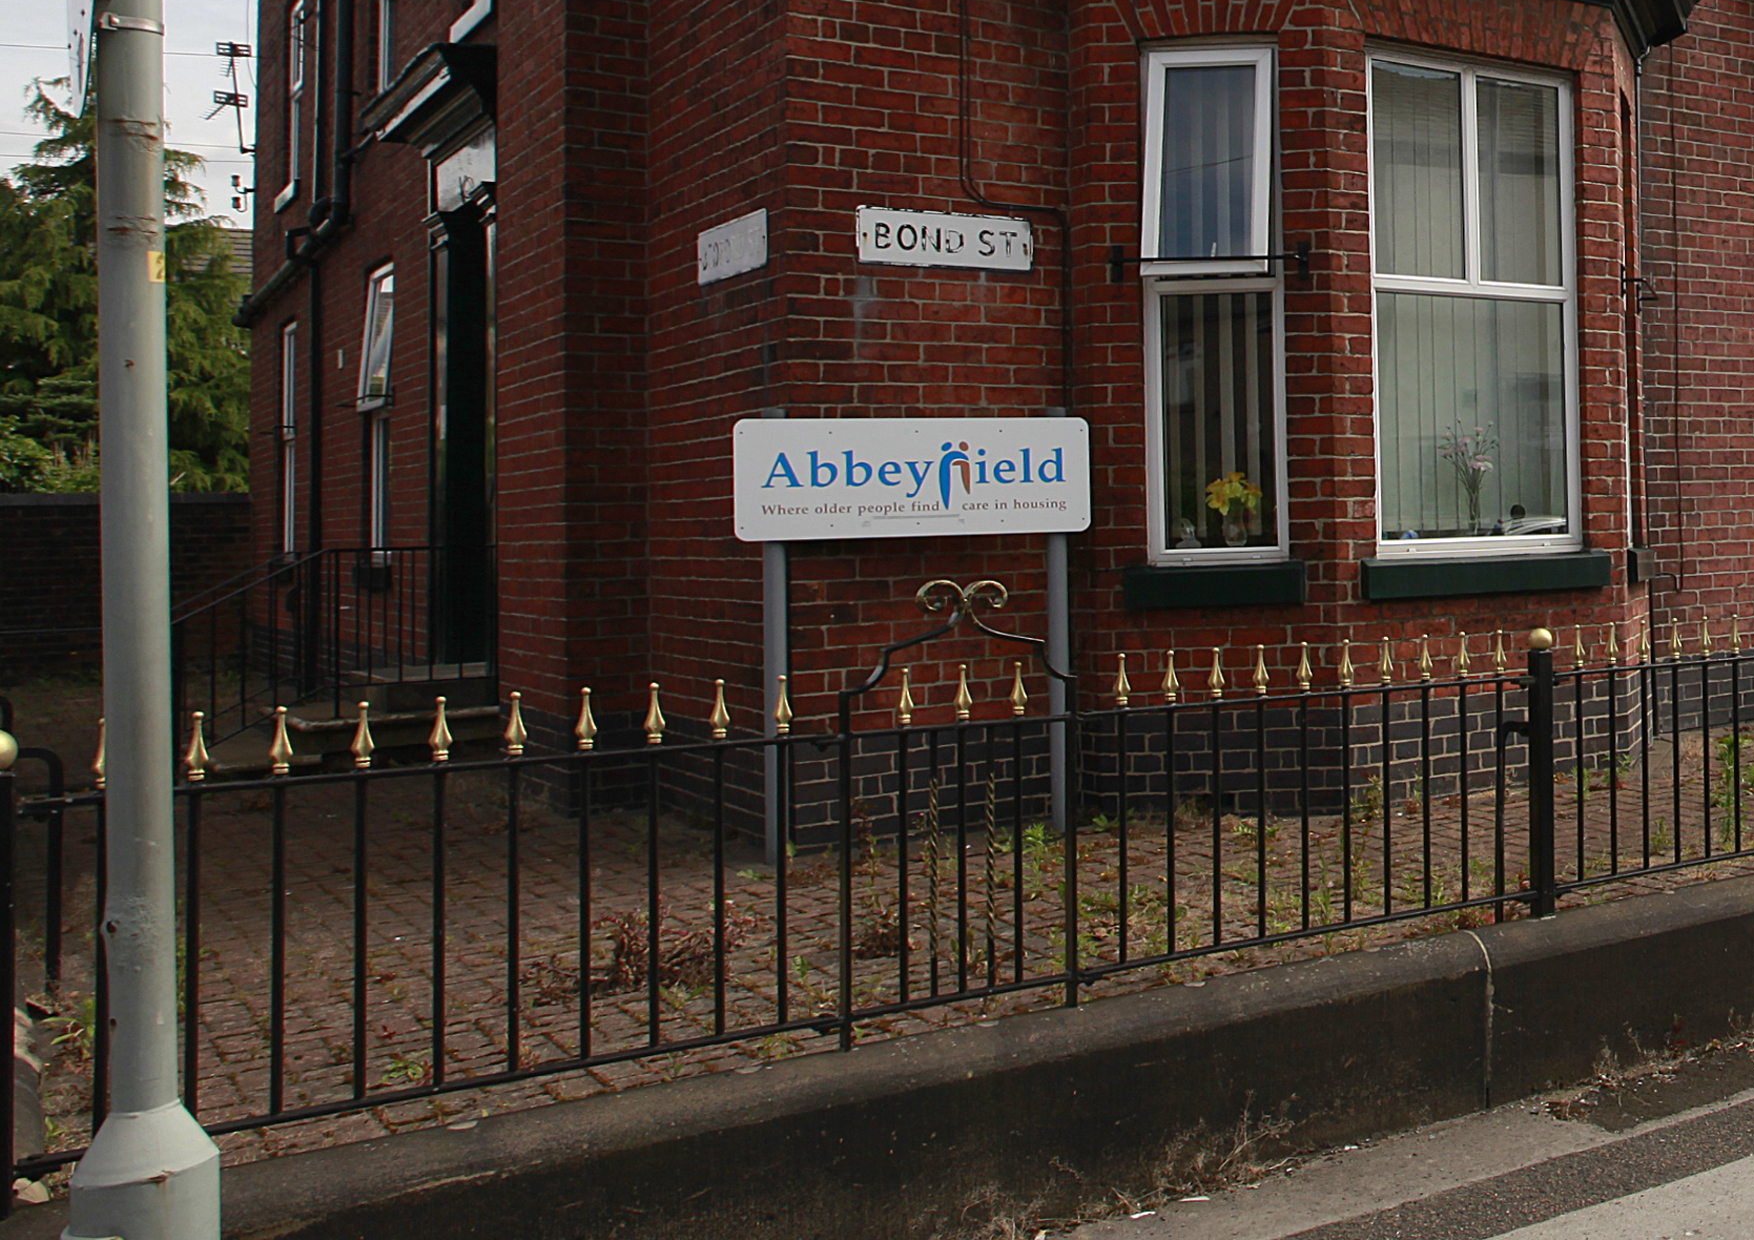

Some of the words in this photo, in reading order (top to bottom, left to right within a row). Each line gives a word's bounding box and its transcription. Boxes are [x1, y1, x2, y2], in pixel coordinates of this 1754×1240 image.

[874, 222, 965, 254] BOND
[978, 229, 1018, 258] ST
[761, 441, 1067, 510] Abbeyfield
[761, 503, 809, 515] Where
[814, 503, 852, 514] older
[857, 501, 906, 517] people
[911, 501, 940, 512] find
[962, 502, 989, 511] care
[994, 499, 1008, 510] in
[1013, 498, 1067, 512] housing
